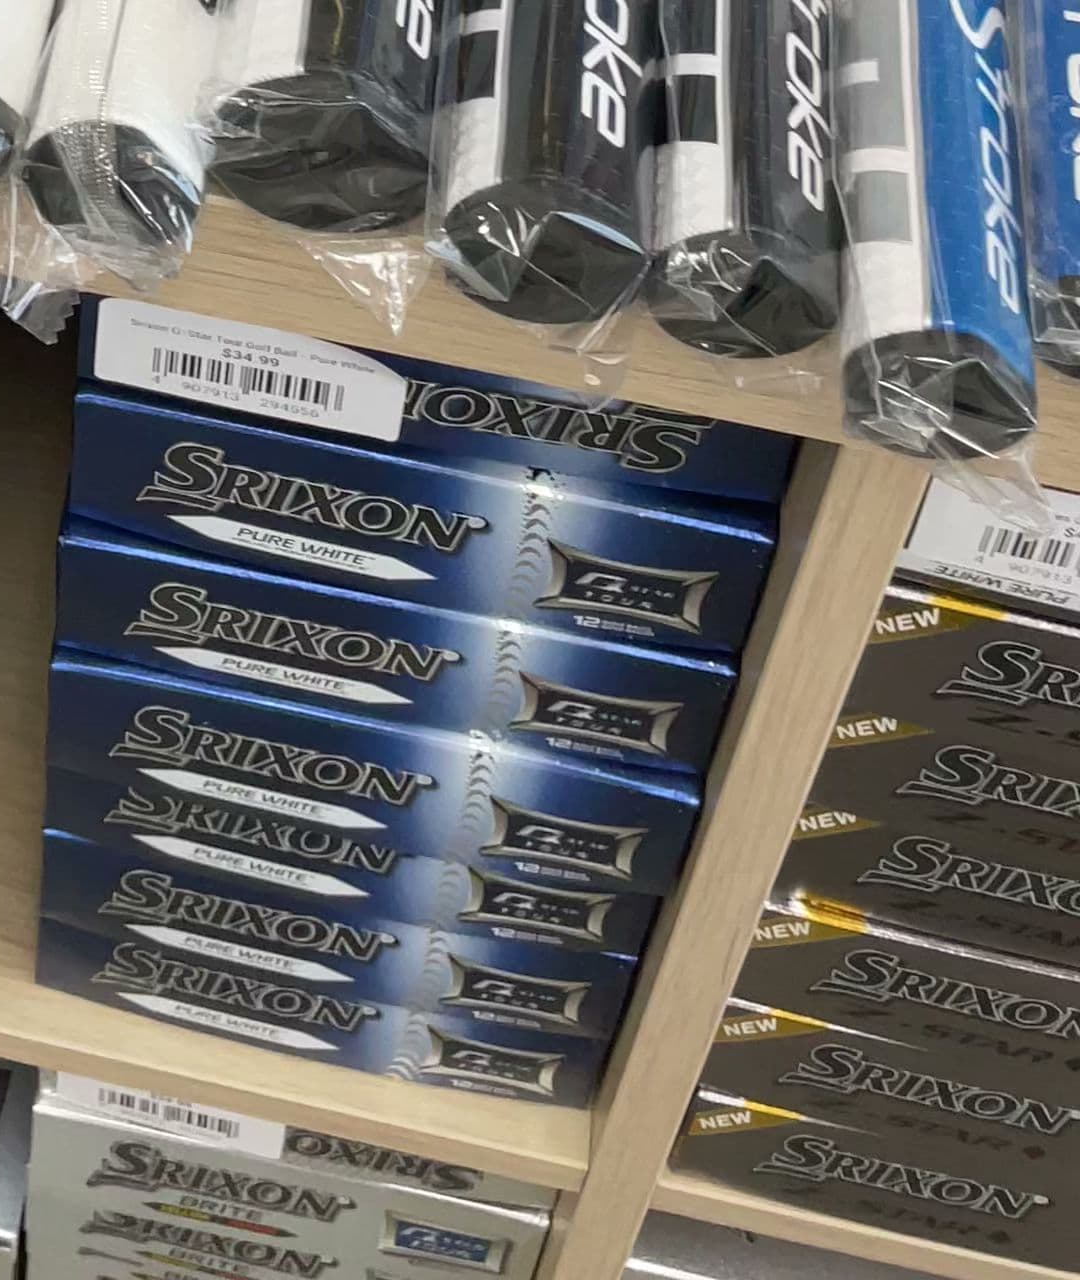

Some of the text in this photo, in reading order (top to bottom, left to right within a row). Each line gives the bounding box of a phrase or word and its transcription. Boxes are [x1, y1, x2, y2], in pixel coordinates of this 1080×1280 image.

[222, 347, 280, 368] $34.99
[136, 441, 475, 551] SRIXON
[236, 526, 367, 567] PURE WHITE
[124, 582, 449, 681] SRIXON
[573, 615, 601, 629] 12
[874, 607, 941, 634] NEW
[221, 657, 346, 692] PURE WHITE
[836, 716, 898, 740] NEW
[109, 705, 421, 807] SRIXON
[202, 779, 321, 816] PURE WHITE
[896, 745, 1080, 818] SRI
[799, 811, 857, 832] NEW
[193, 846, 308, 884] PURE WHITE
[857, 835, 1080, 917] SRIXO
[98, 870, 387, 961] SRIXON
[755, 919, 811, 941] NEW
[91, 943, 370, 1032] SRIXON
[722, 1017, 778, 1037] NEW
[778, 1043, 1070, 1135] SRIXON
[699, 1110, 752, 1130] NEW
[288, 1126, 485, 1191] SRIXO
[753, 1134, 1035, 1219] SRIXON
[86, 1140, 348, 1223] SRIXON
